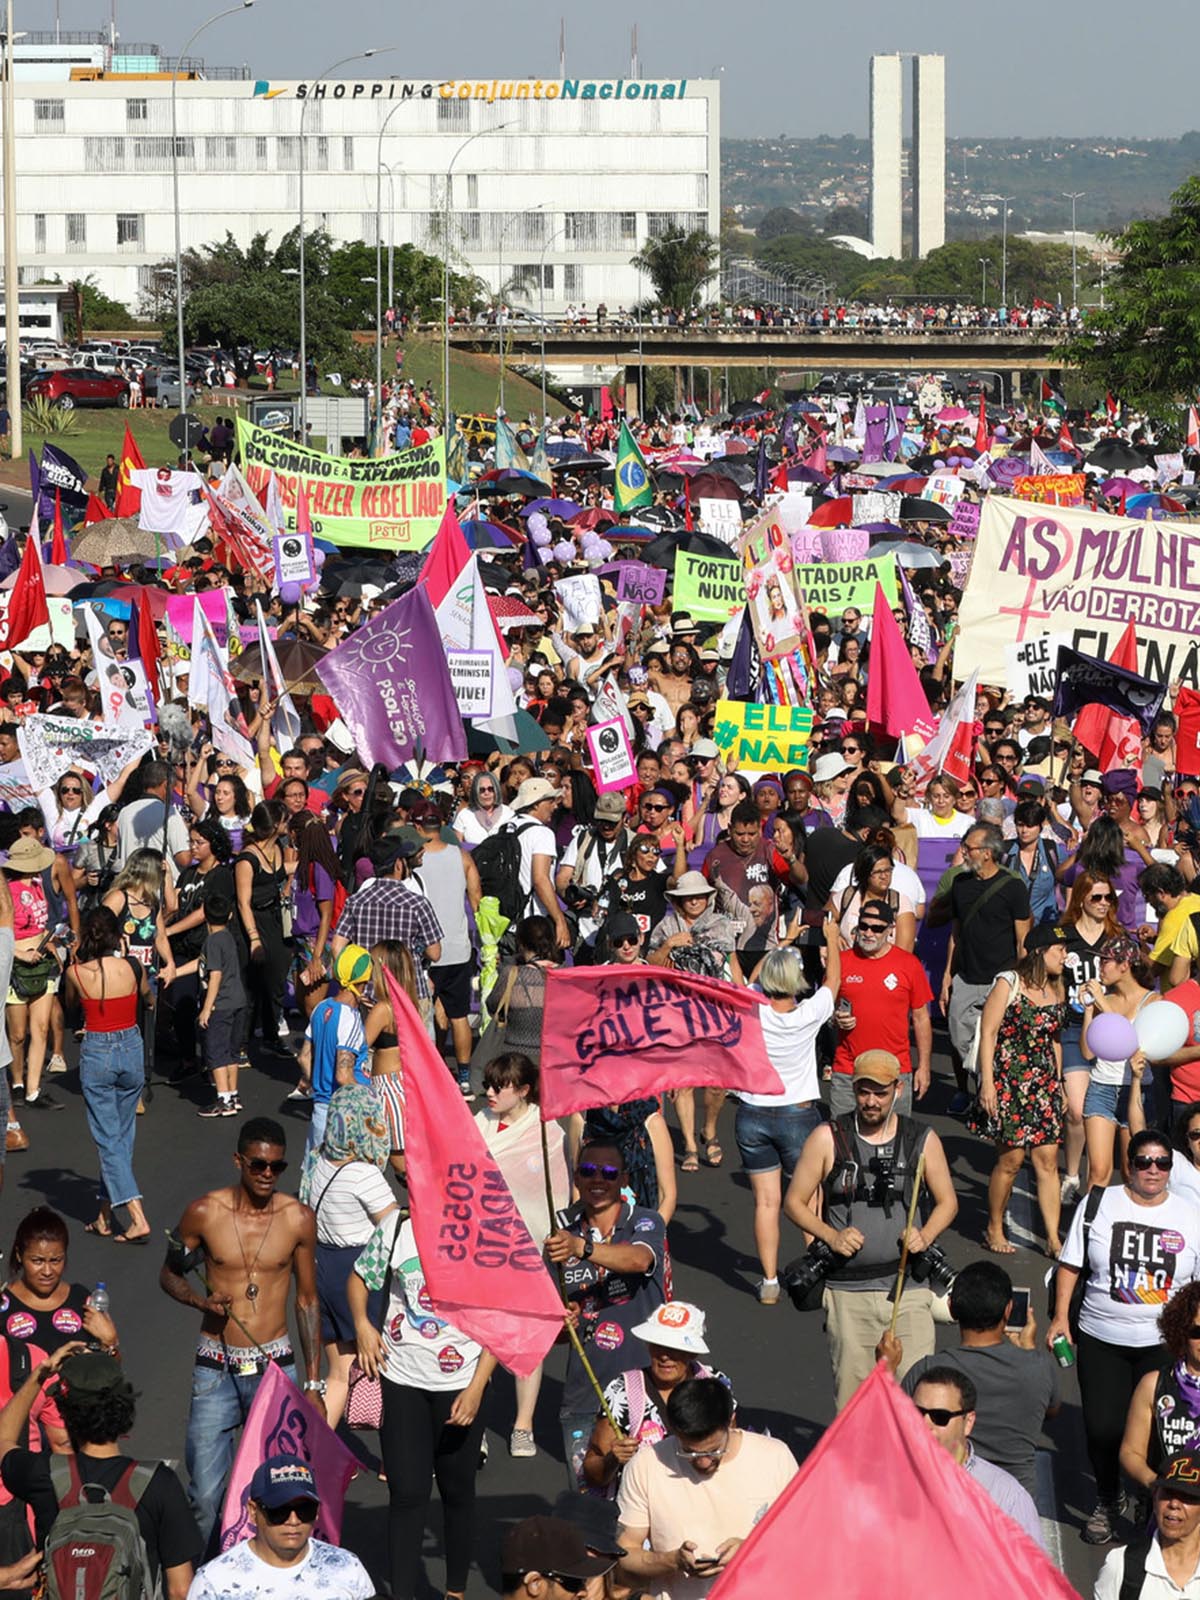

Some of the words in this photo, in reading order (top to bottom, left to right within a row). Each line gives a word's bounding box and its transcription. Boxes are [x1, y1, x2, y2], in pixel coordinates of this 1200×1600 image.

[296, 83, 432, 100] SHOPPING
[438, 80, 560, 103] Conjunto
[561, 79, 687, 100] Nacional
[246, 442, 332, 477] BOLSONARO
[350, 460, 441, 482] EXPLORAÇÃO
[934, 478, 951, 491] ELE
[305, 479, 355, 517] FAZER
[361, 481, 444, 519] REBELIÃO!
[710, 503, 733, 519] ELE
[374, 524, 406, 537] PSTU
[998, 515, 1062, 580] AS
[686, 556, 744, 582] TORTU
[622, 583, 658, 601] NÃO
[698, 581, 748, 601] NUNC
[1041, 584, 1088, 613] VÃO
[1017, 638, 1051, 667] #ELE
[455, 686, 487, 701] VIVE!
[1027, 666, 1057, 695] NÃO
[375, 677, 401, 719] PSOL
[388, 719, 408, 747] 50
[743, 702, 814, 733] ELE
[738, 734, 810, 768] NÃO
[1121, 1229, 1165, 1265] ELE
[564, 1267, 593, 1284] SEA
[1113, 1262, 1169, 1291] NÃO
[206, 1339, 246, 1355] Cavin
[1164, 1416, 1195, 1432] Lula
